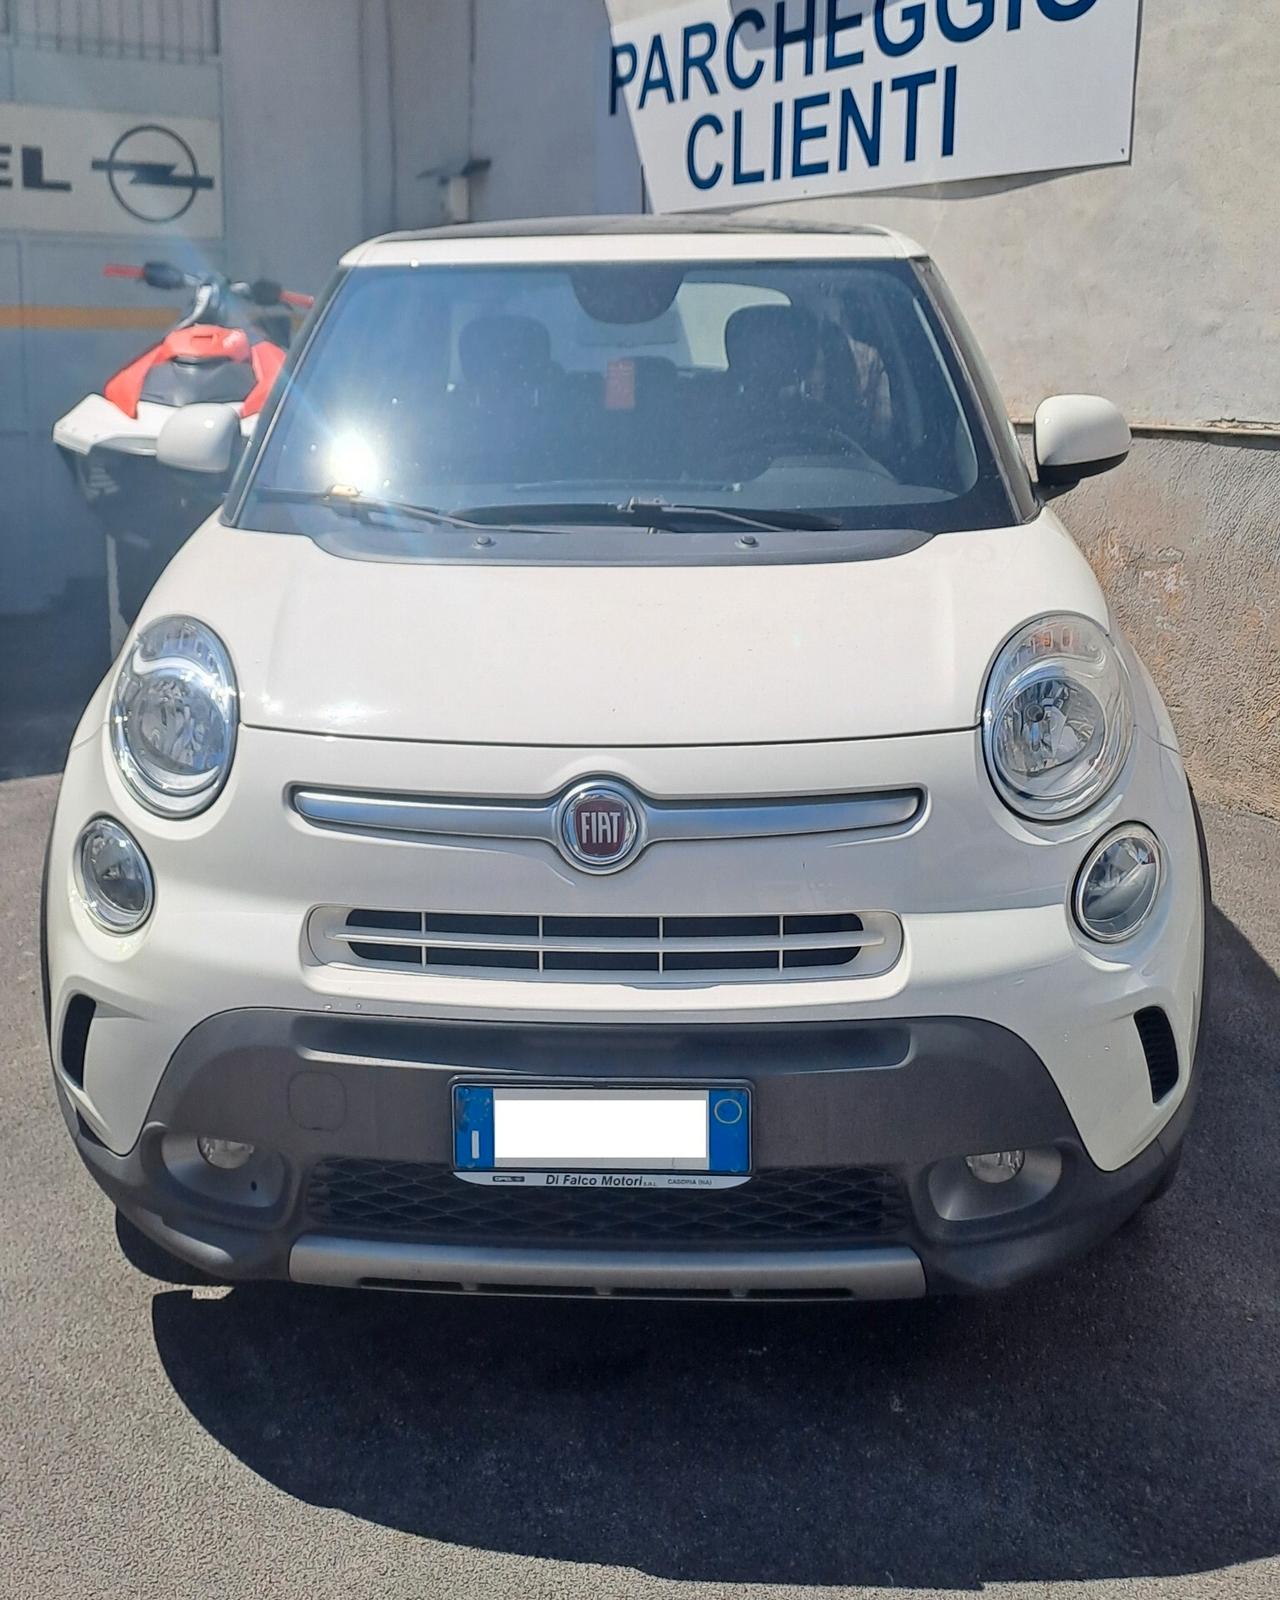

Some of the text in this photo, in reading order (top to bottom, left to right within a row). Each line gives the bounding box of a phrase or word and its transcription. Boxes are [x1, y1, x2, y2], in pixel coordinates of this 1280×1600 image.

[610, 0, 1096, 116] PARCHEG
[687, 65, 958, 190] CLIENTI
[0, 145, 72, 192] L
[580, 811, 622, 844] FIAT
[562, 1174, 598, 1186] Falco
[600, 1175, 644, 1186] Motori
